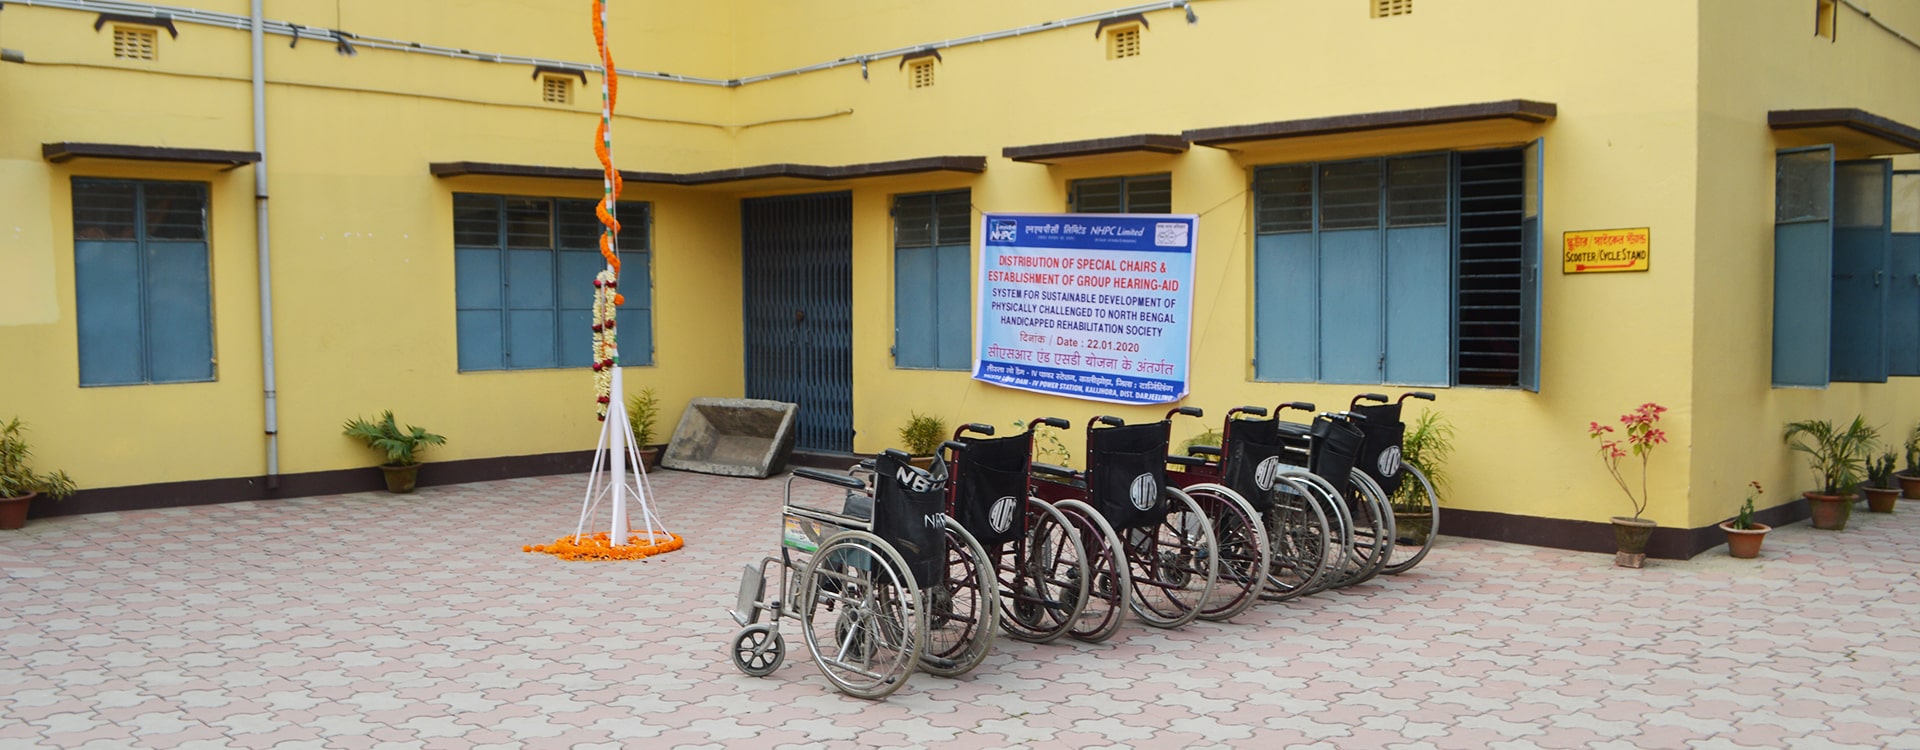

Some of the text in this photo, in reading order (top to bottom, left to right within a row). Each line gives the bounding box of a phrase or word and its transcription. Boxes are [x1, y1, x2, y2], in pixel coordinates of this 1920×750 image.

[990, 230, 1015, 241] NHPC
[1090, 226, 1145, 236] NHPC Limited
[999, 255, 1167, 273] DISTRIBUTION OF SPECIAL CHAIRS &
[1622, 248, 1646, 261] STAND
[988, 270, 1179, 291] ESTABLISHMENT OF GROUP HEARING-AID
[992, 287, 1177, 308] SYSTEM FOR SUSTAINABLE DEVELOPMENT OF
[991, 301, 1176, 324] PHYSICALLY CHALLENGED TO NORTH BENGAL
[1000, 316, 1164, 337] HANDICAPPED REHABILITATION SOCIETY
[1020, 330, 1046, 344] दिनांक
[1056, 336, 1079, 348] Date
[1087, 339, 1140, 353] 22.01.2020
[988, 343, 1175, 376] सीएसआर एंड एसडी योजना के अंतर्गत
[1015, 378, 1029, 386] DAM
[1039, 381, 1059, 390] POWER
[1060, 383, 1084, 393] STATION,
